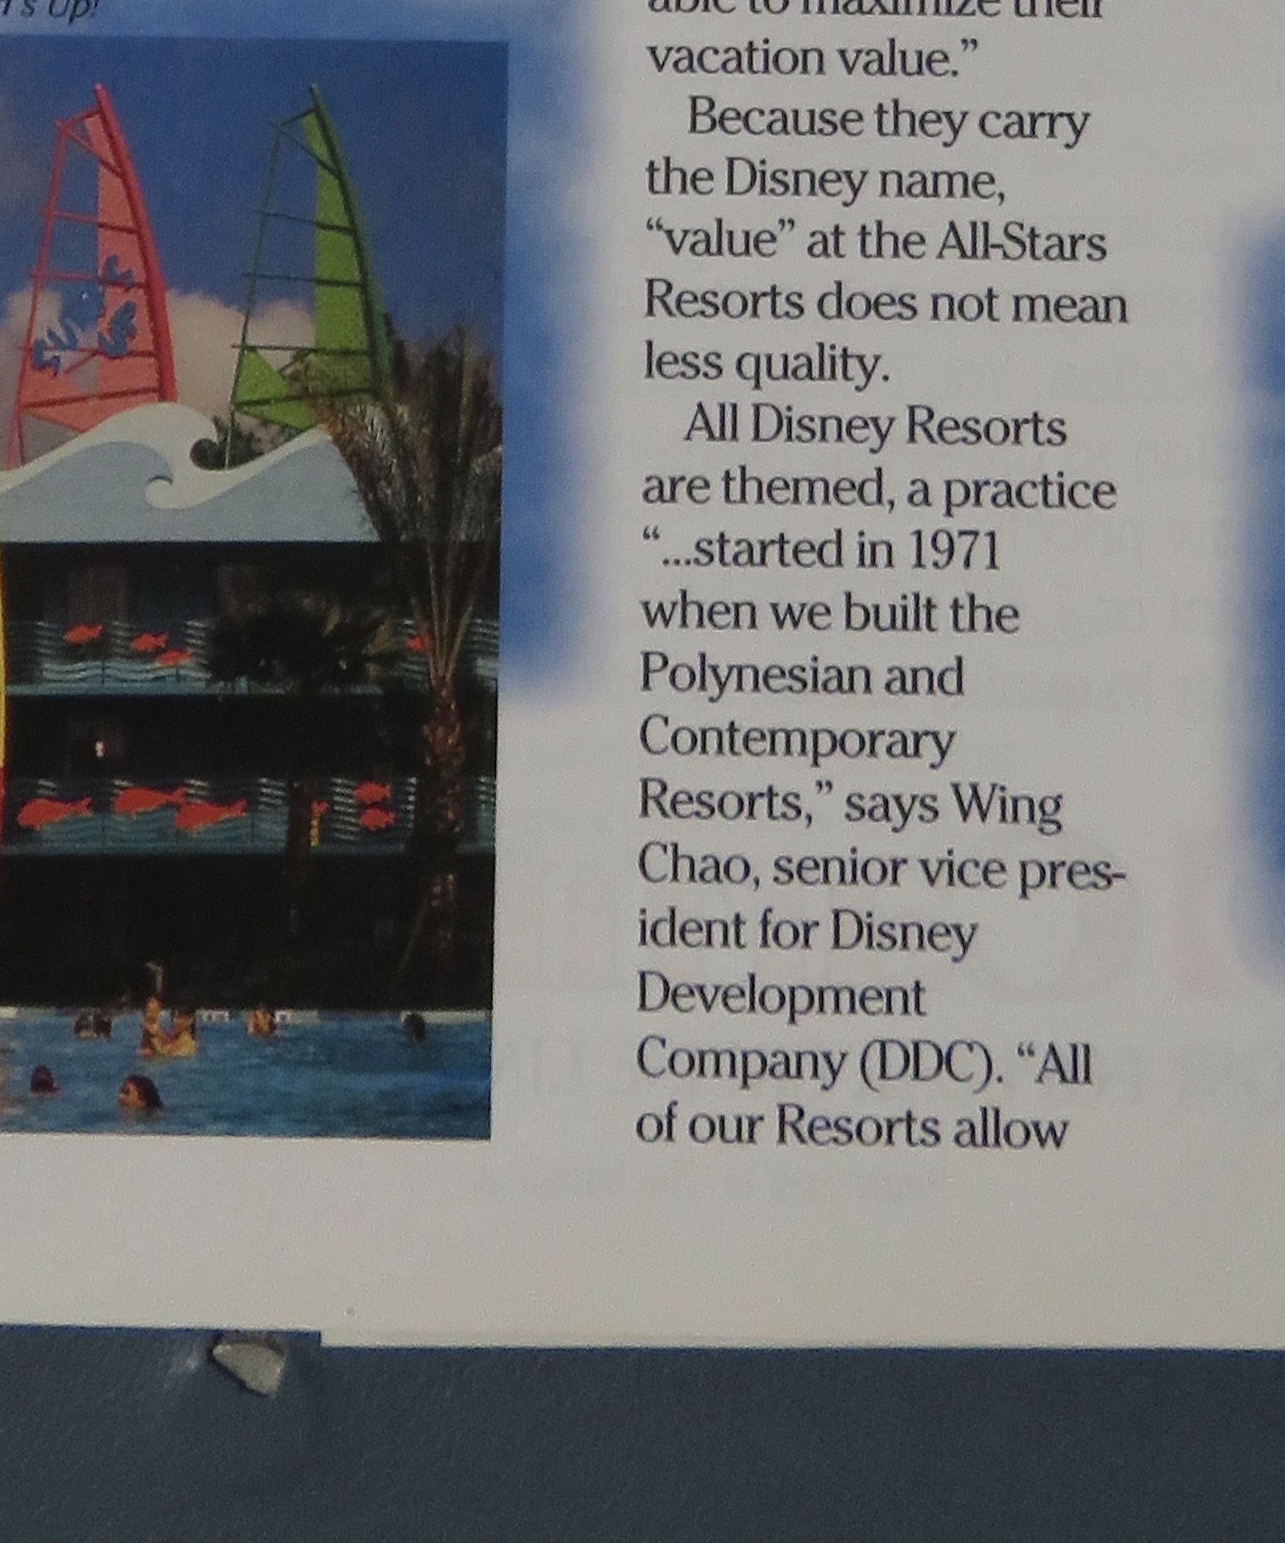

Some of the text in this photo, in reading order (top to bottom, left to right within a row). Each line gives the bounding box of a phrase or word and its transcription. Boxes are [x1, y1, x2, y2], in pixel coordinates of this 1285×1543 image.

[683, 401, 1068, 455] All Disney Resorts
[641, 650, 964, 703] Polynesian and
[640, 713, 957, 770] Contemporary
[637, 970, 927, 1025] Development
